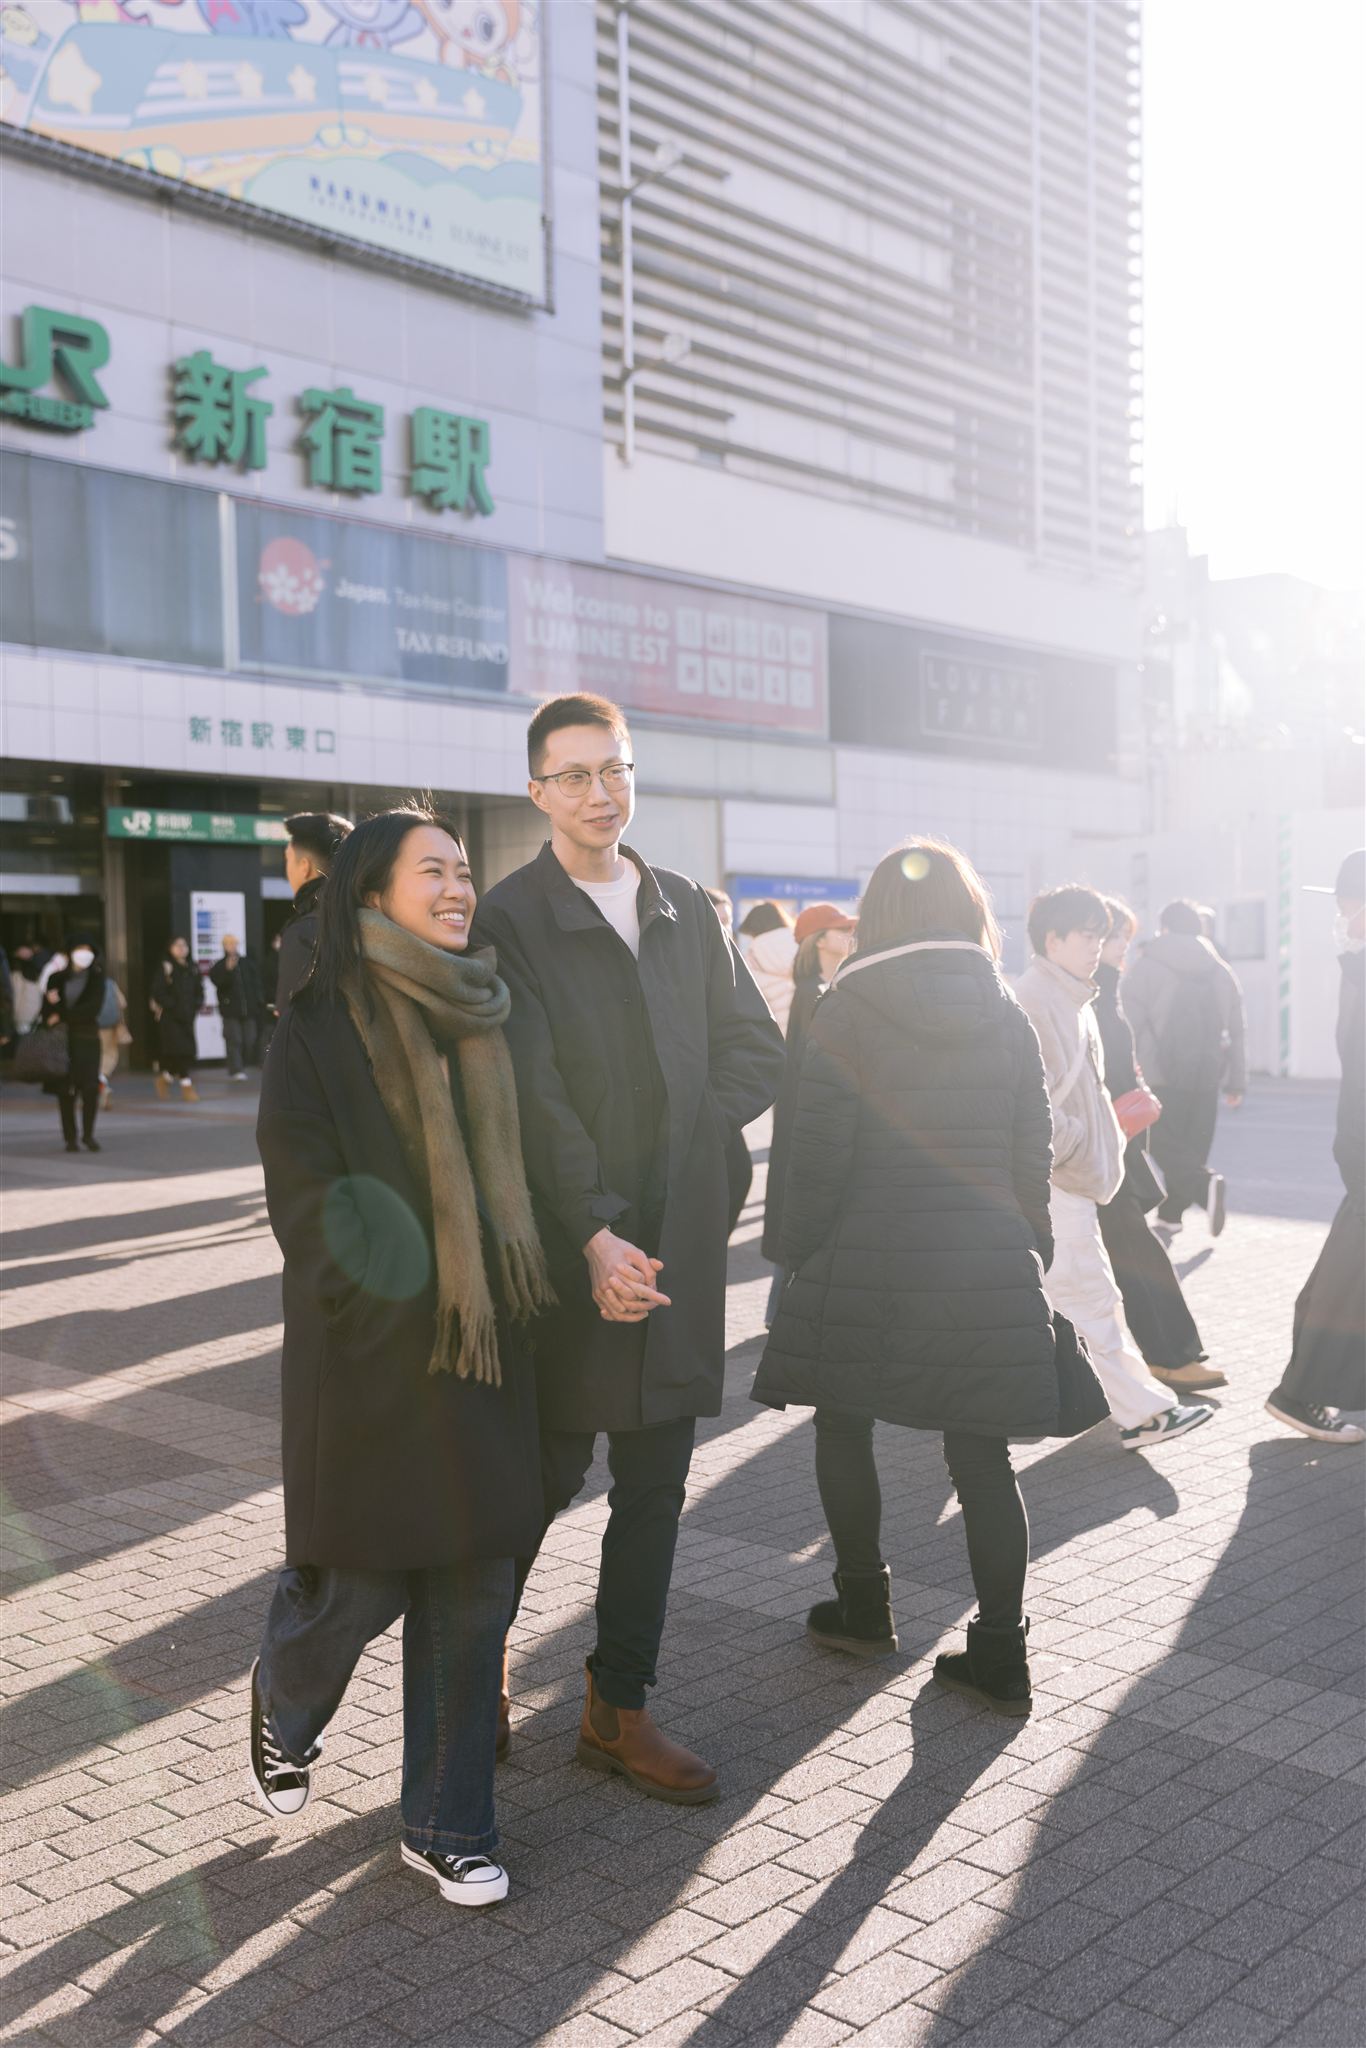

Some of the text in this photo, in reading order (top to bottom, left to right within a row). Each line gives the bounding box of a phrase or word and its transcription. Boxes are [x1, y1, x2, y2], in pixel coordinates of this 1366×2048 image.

[0, 305, 495, 517] JR 新宿駅
[522, 578, 670, 632] Welcome to
[395, 626, 509, 665] TAX REFUND
[524, 616, 670, 667] LUMINE EST
[189, 716, 337, 755] 新宿駅東口
[122, 810, 152, 832] JR
